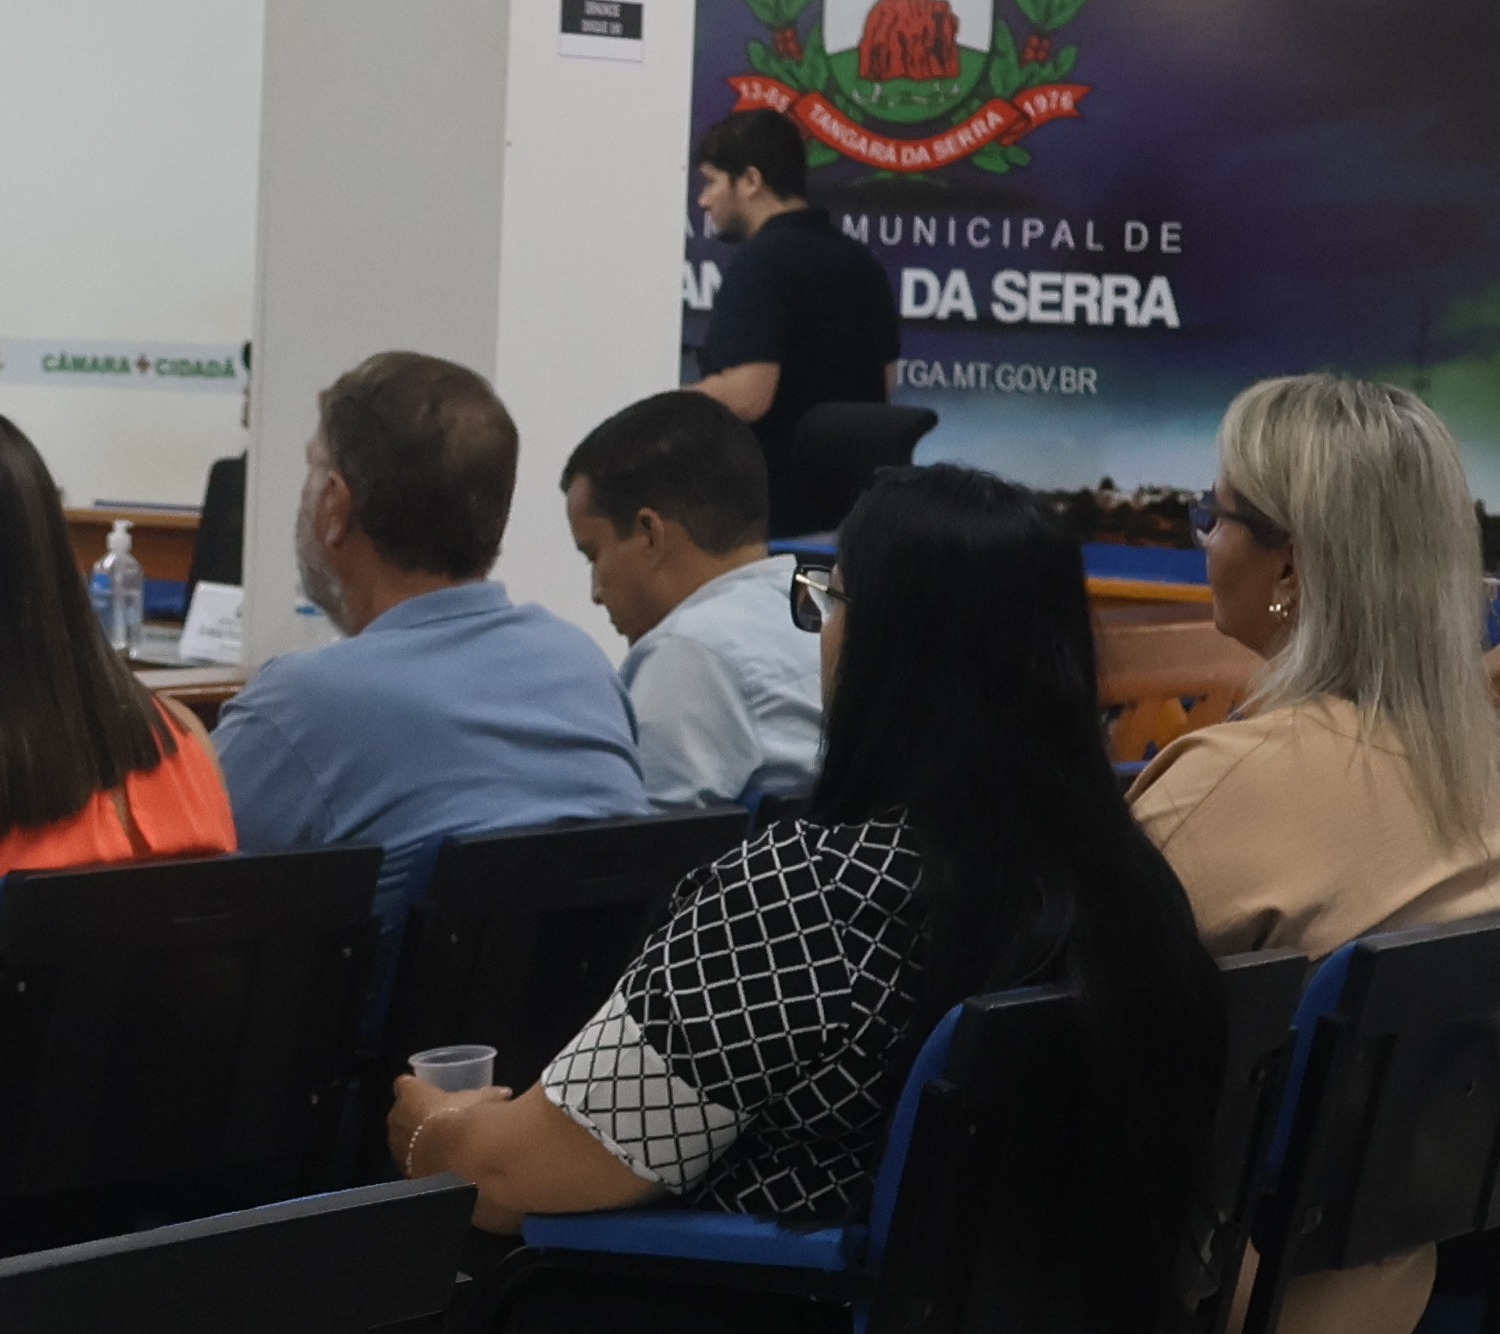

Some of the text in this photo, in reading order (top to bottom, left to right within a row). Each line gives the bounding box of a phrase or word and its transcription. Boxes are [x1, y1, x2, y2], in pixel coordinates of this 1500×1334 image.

[808, 103, 898, 165] TANGARÁ
[901, 145, 931, 166] DA
[932, 110, 1004, 160] SERRA
[1022, 91, 1076, 128] 1976
[842, 213, 1183, 254] MUNICIPAL DE
[902, 268, 978, 320] DA
[990, 271, 1180, 328] SERRA
[42, 351, 132, 374] CÂMARA
[156, 357, 236, 378] CIDADÃ
